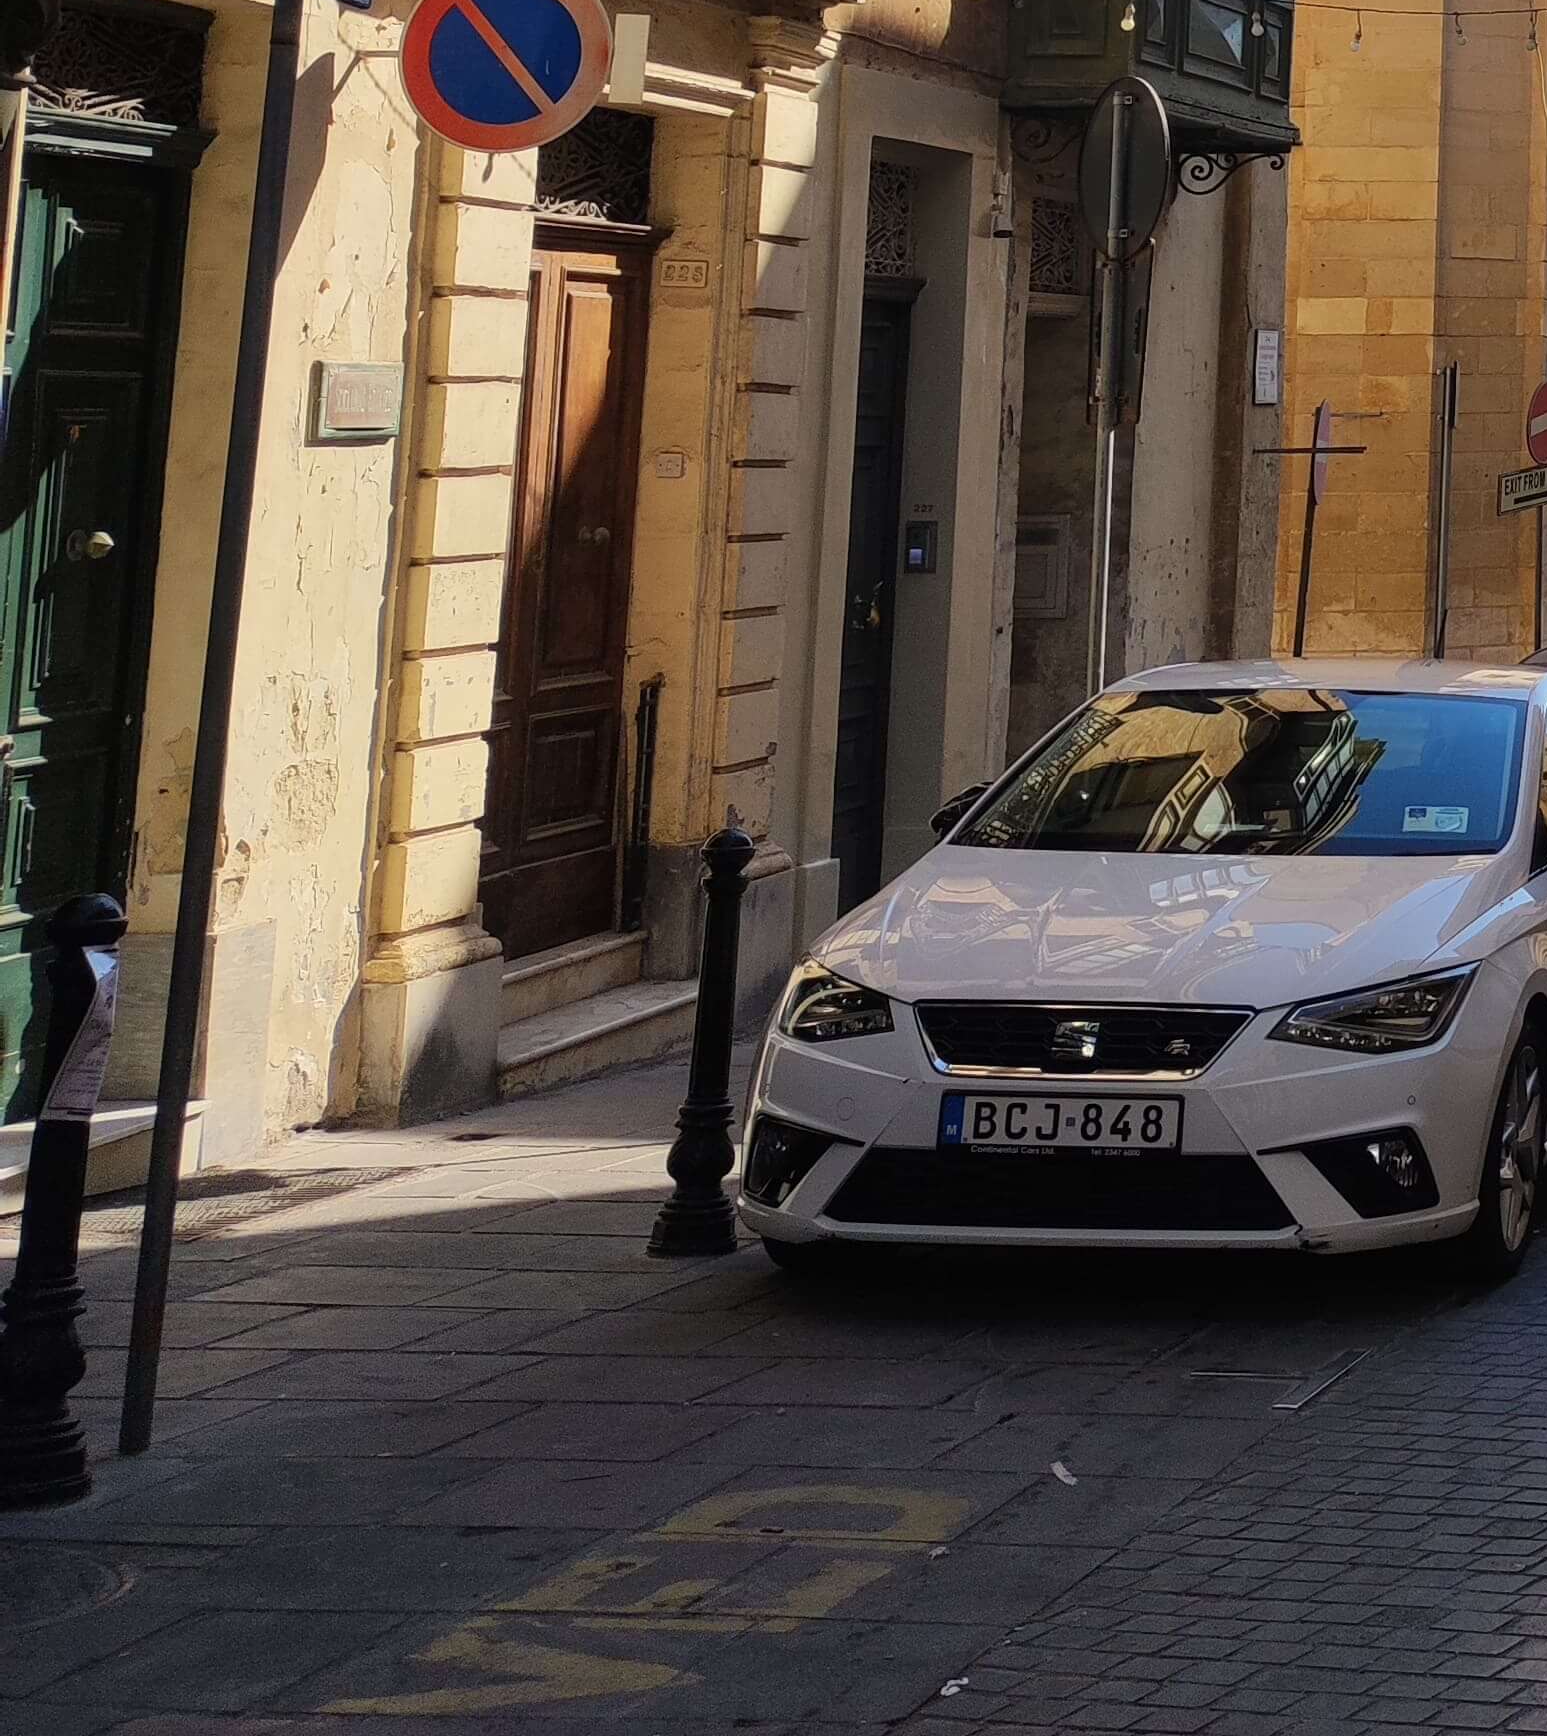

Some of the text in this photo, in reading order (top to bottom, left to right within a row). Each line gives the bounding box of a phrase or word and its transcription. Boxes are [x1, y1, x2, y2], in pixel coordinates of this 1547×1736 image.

[1504, 475, 1523, 495] EXIT
[1523, 470, 1546, 490] FROM
[913, 504, 934, 513] 227
[972, 1101, 1164, 1143] BCJ 848
[946, 1124, 958, 1136] M
[970, 1145, 1019, 1154] Continental
[1020, 1146, 1040, 1155] Cars
[1104, 1148, 1122, 1156] 2347
